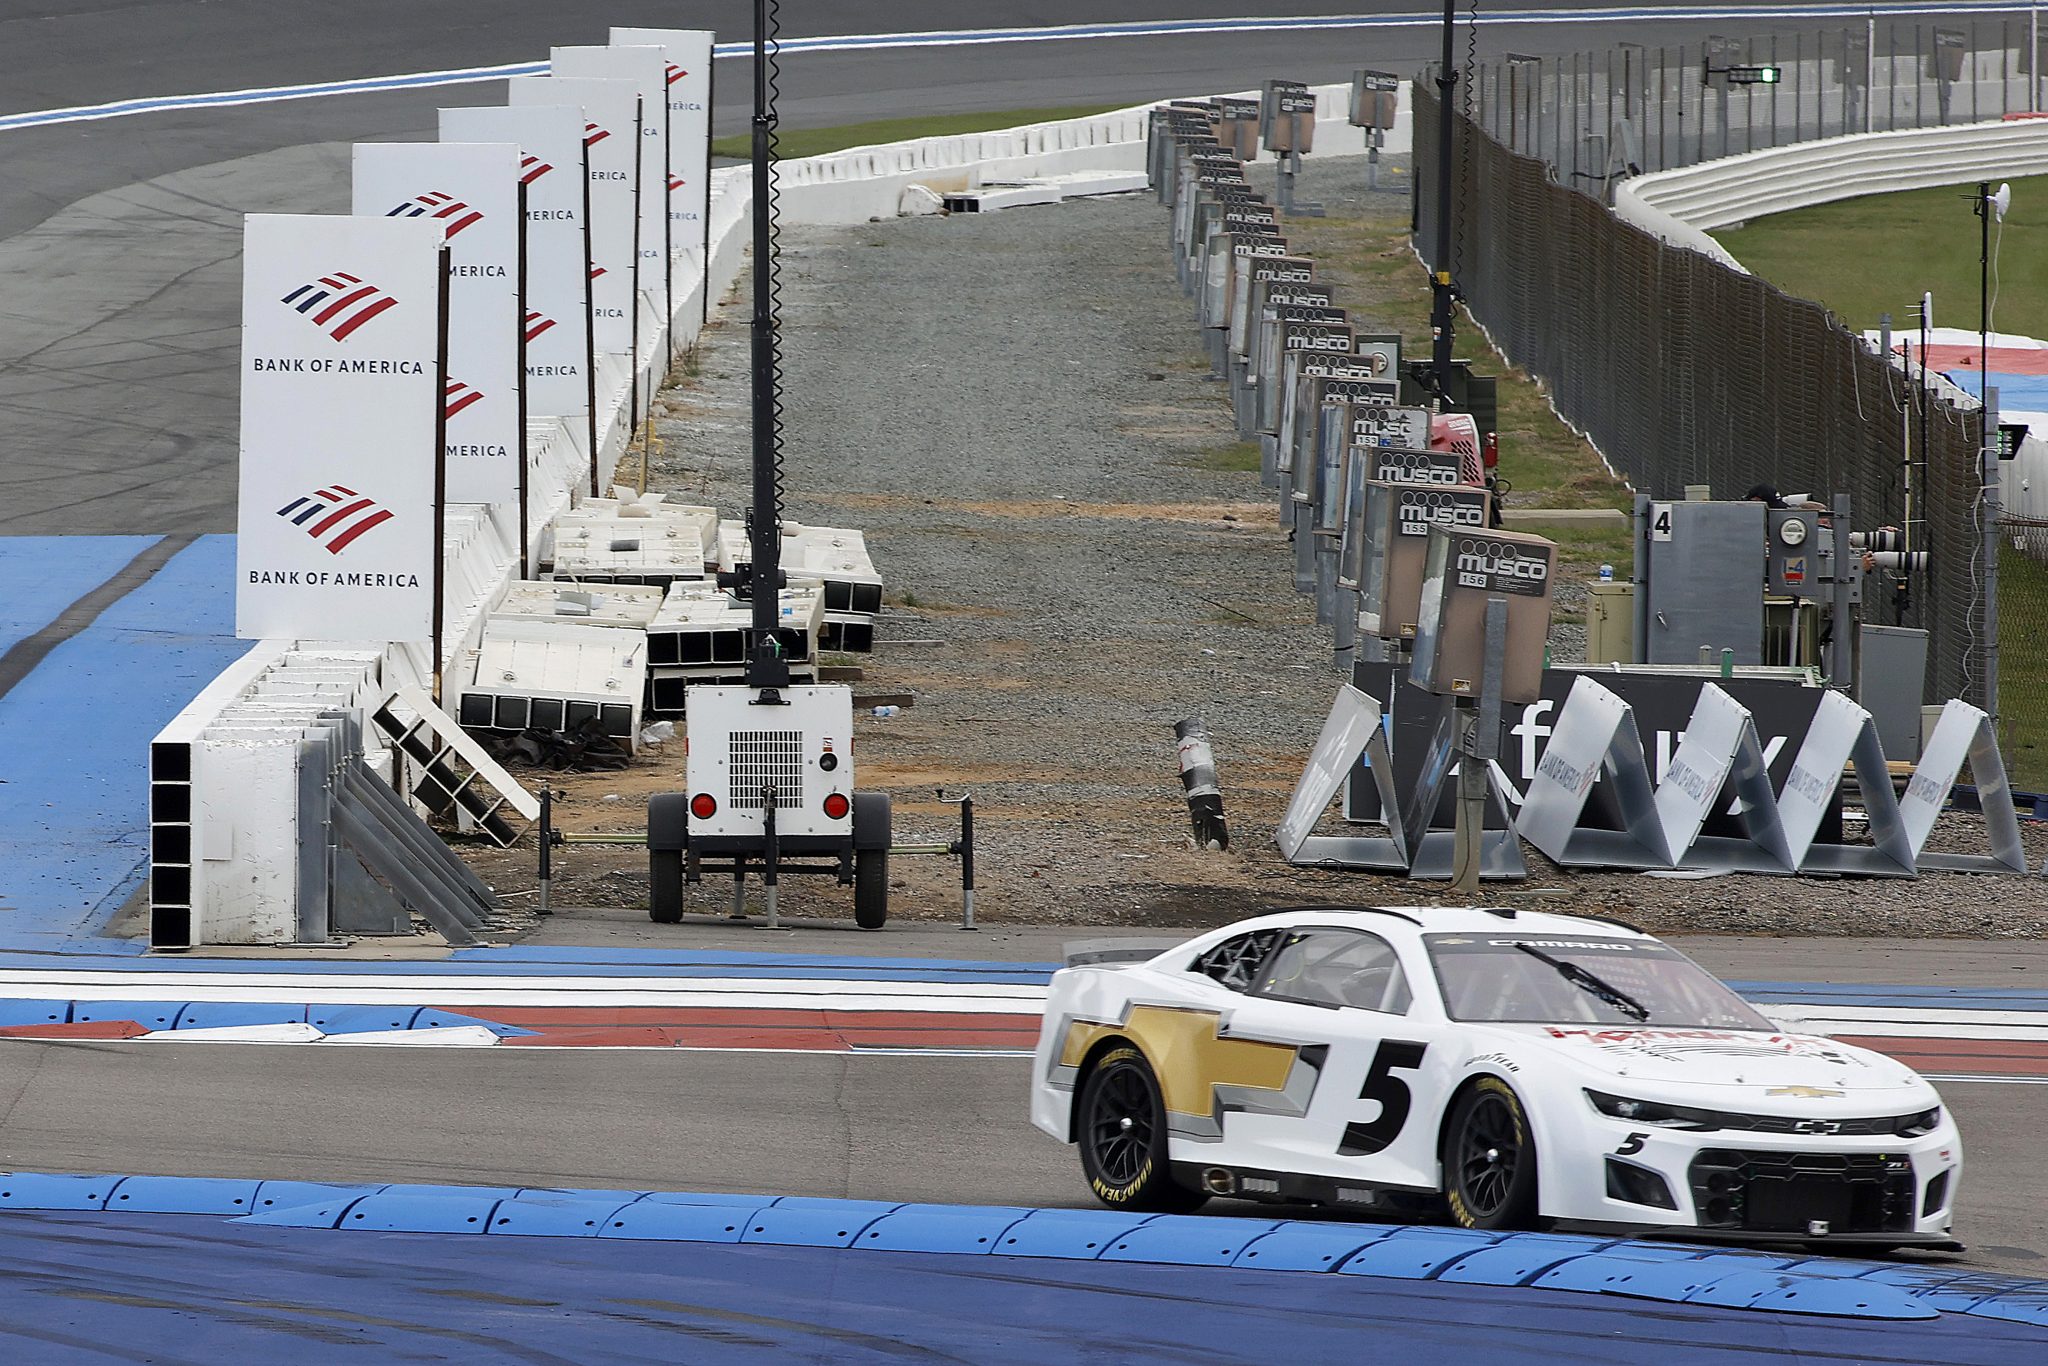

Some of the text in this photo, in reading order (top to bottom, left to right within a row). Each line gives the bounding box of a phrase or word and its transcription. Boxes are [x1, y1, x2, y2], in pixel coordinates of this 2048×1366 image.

[668, 102, 701, 111] ERICA
[590, 171, 627, 181] ERICA
[526, 210, 574, 221] ERICA
[449, 266, 506, 277] MERICA
[595, 309, 624, 318] RICA
[254, 358, 423, 375] BANK OF AMERICA
[526, 365, 577, 376] MERICA
[446, 445, 507, 457] MERICA
[1655, 512, 1670, 534] 4
[1405, 525, 1426, 533] 155
[249, 570, 419, 588] BANK OF AMERICA
[1463, 575, 1485, 585] 156
[1336, 1038, 1430, 1157] 5
[1616, 1133, 1650, 1155] 5
